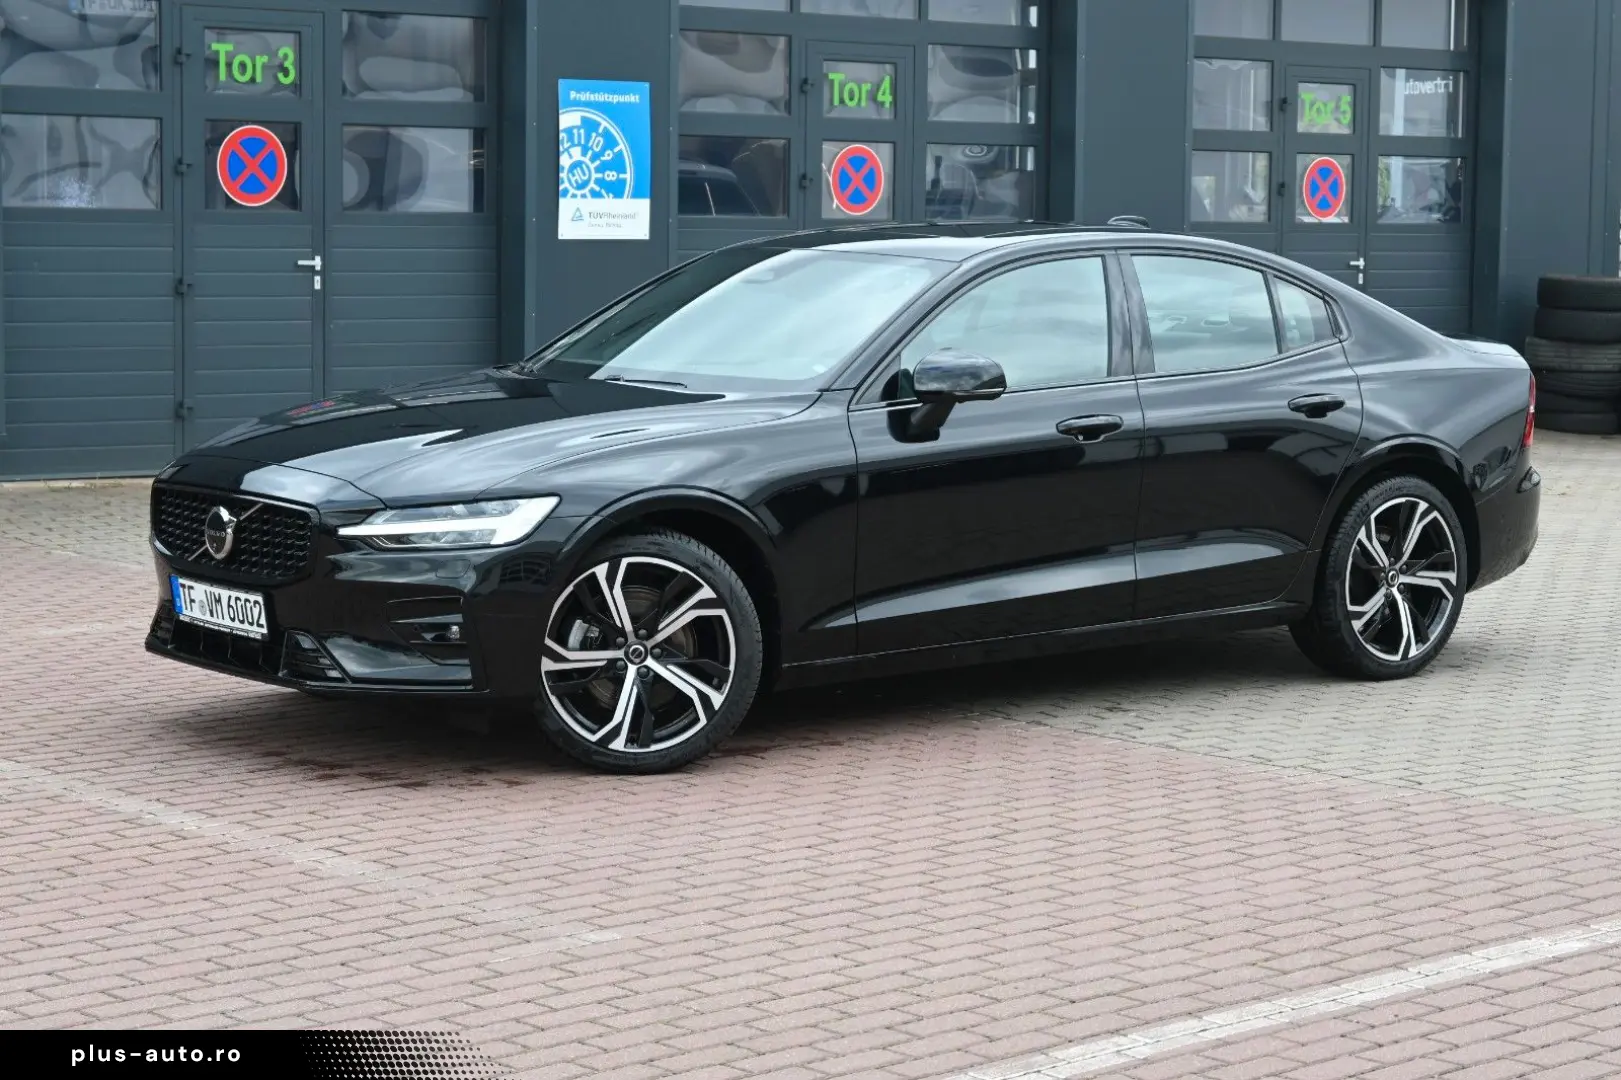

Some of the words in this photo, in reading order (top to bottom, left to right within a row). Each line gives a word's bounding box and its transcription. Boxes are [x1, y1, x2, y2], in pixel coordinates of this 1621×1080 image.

[211, 43, 269, 83] Tor
[277, 46, 296, 85] 3
[569, 90, 641, 104] Prüfstützpunkt
[828, 72, 872, 108] Tor
[877, 74, 893, 109] 4
[1301, 92, 1335, 125] Tor
[1340, 95, 1352, 125] 5
[572, 128, 585, 145] 11
[588, 132, 604, 152] 10
[600, 150, 613, 161] 9
[568, 163, 590, 188] HU
[604, 170, 618, 181] 8
[180, 582, 196, 612] TF
[204, 589, 225, 621] VM
[227, 594, 265, 629] 6002
